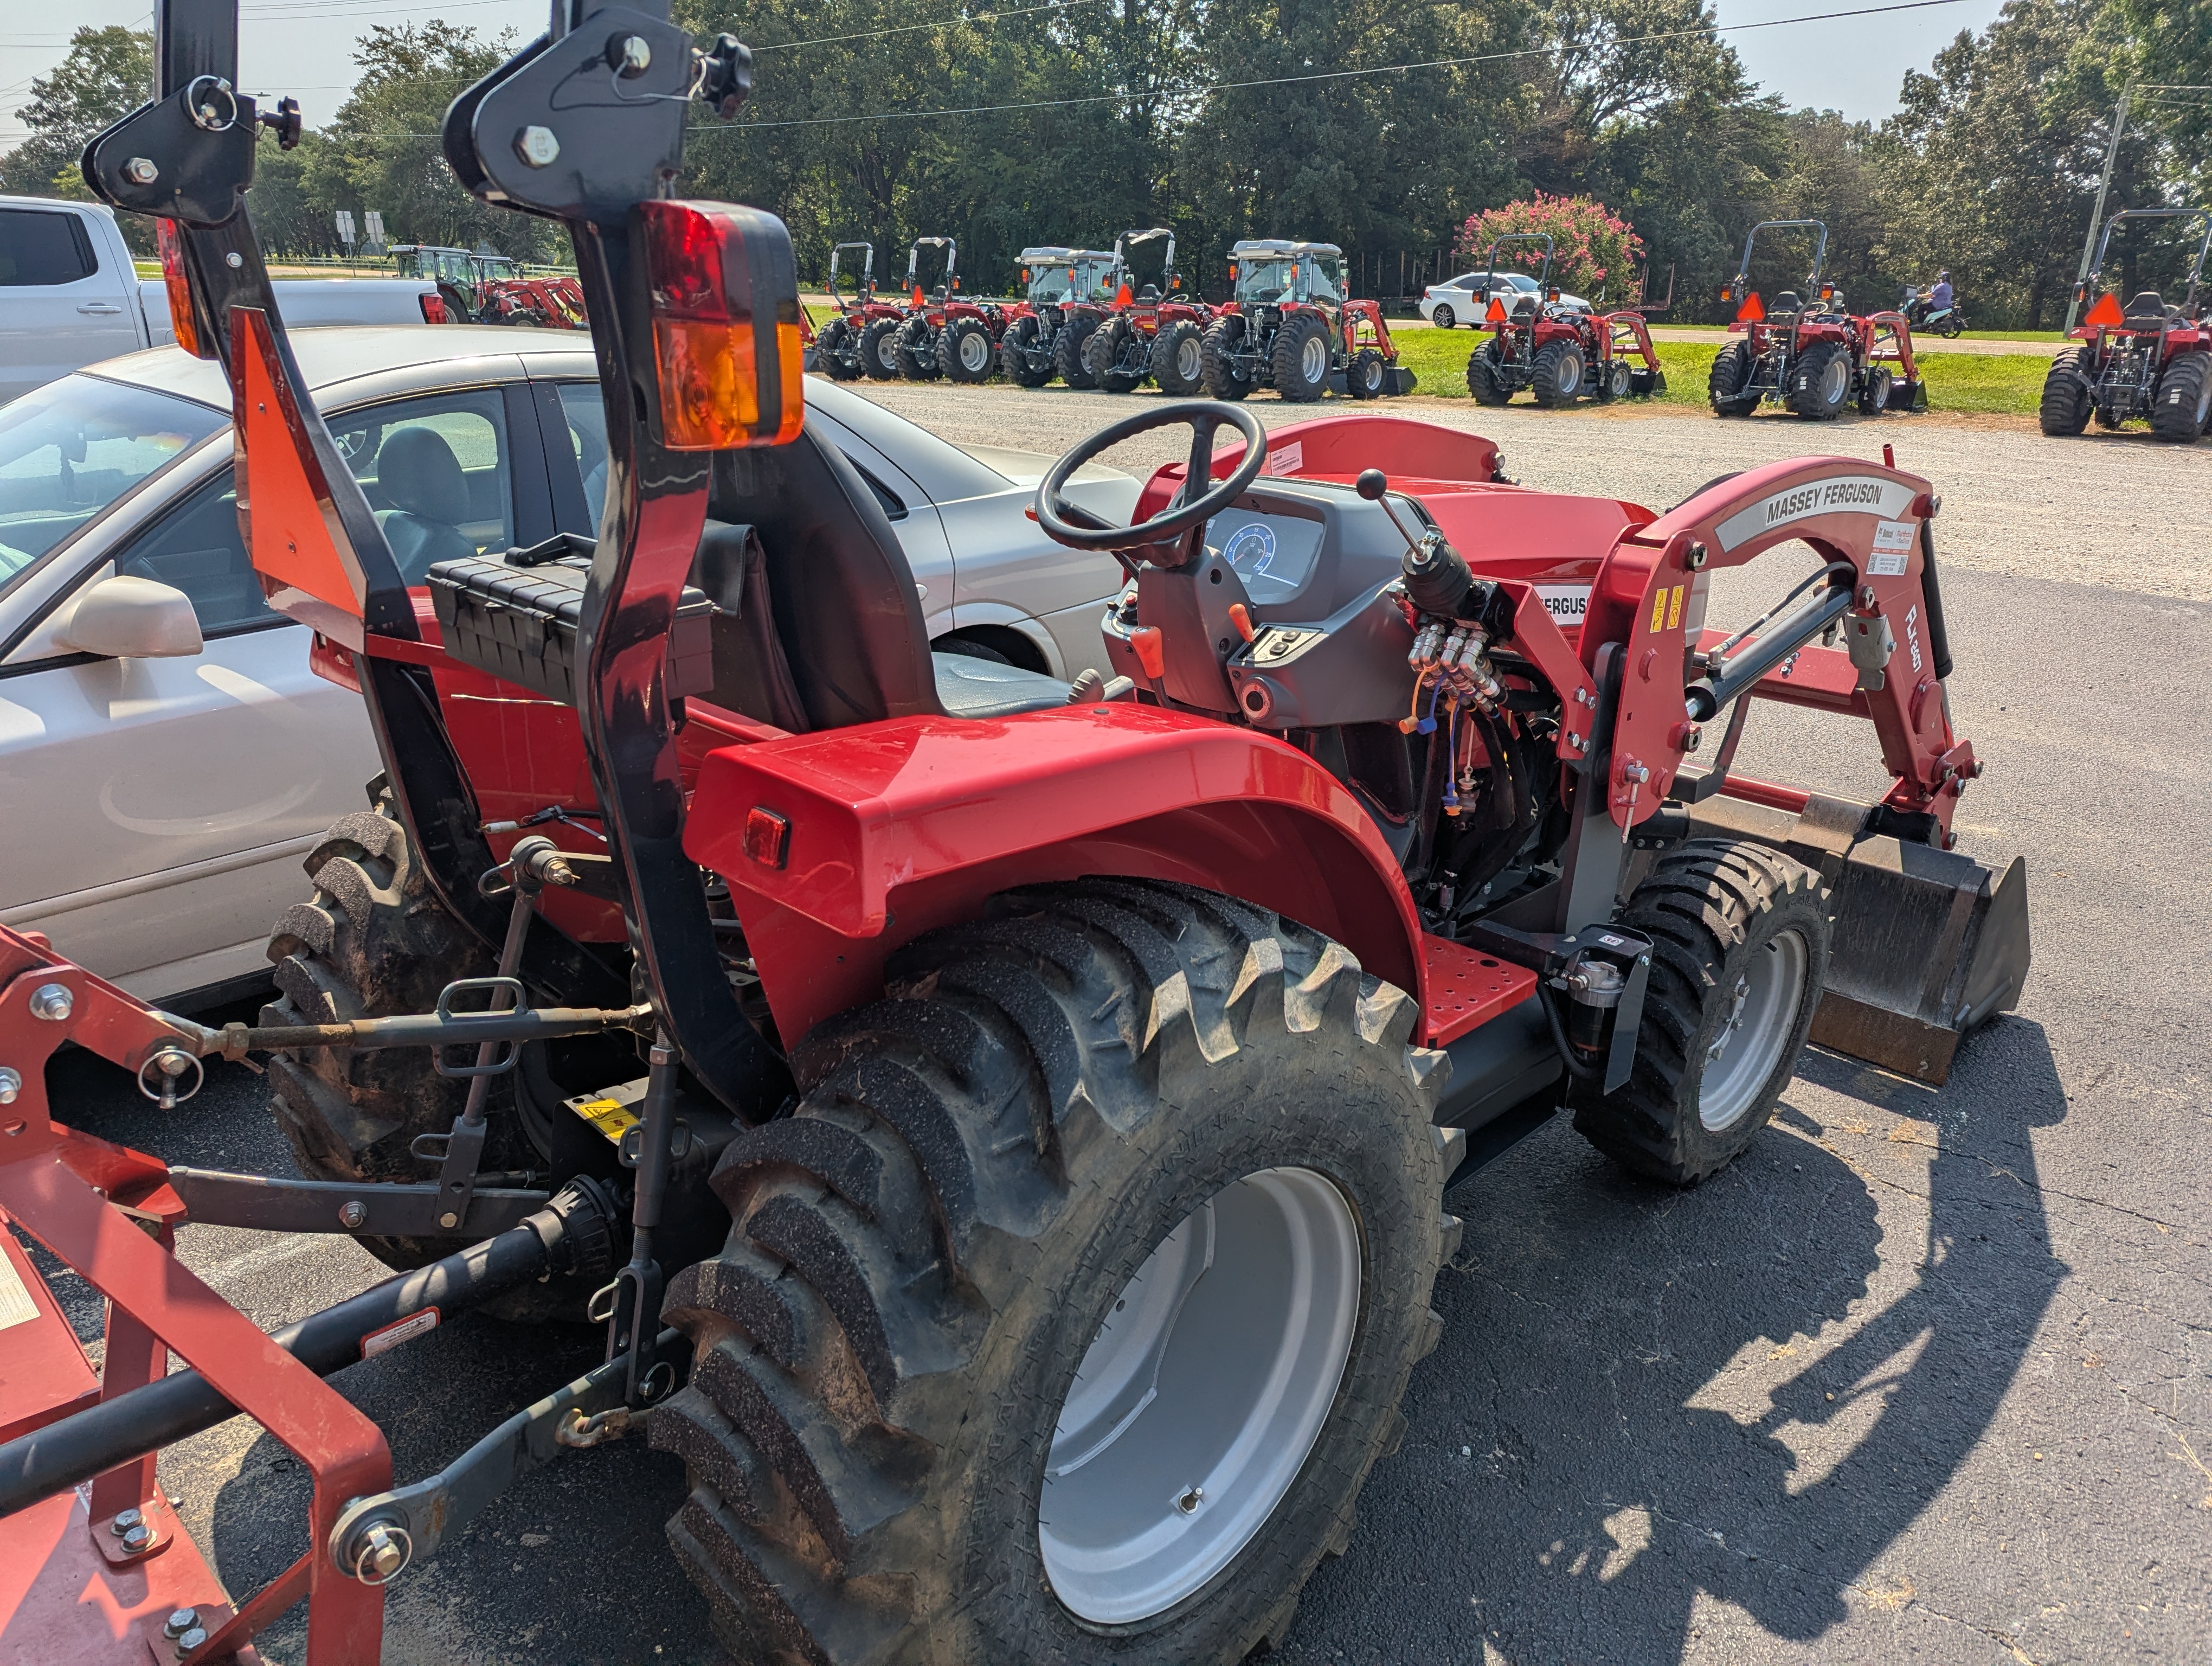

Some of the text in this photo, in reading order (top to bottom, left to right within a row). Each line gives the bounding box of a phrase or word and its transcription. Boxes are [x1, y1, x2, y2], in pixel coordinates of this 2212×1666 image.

[1766, 483, 1883, 524] MASSEY FERGUSON
[1540, 598, 1589, 614] ERGUS
